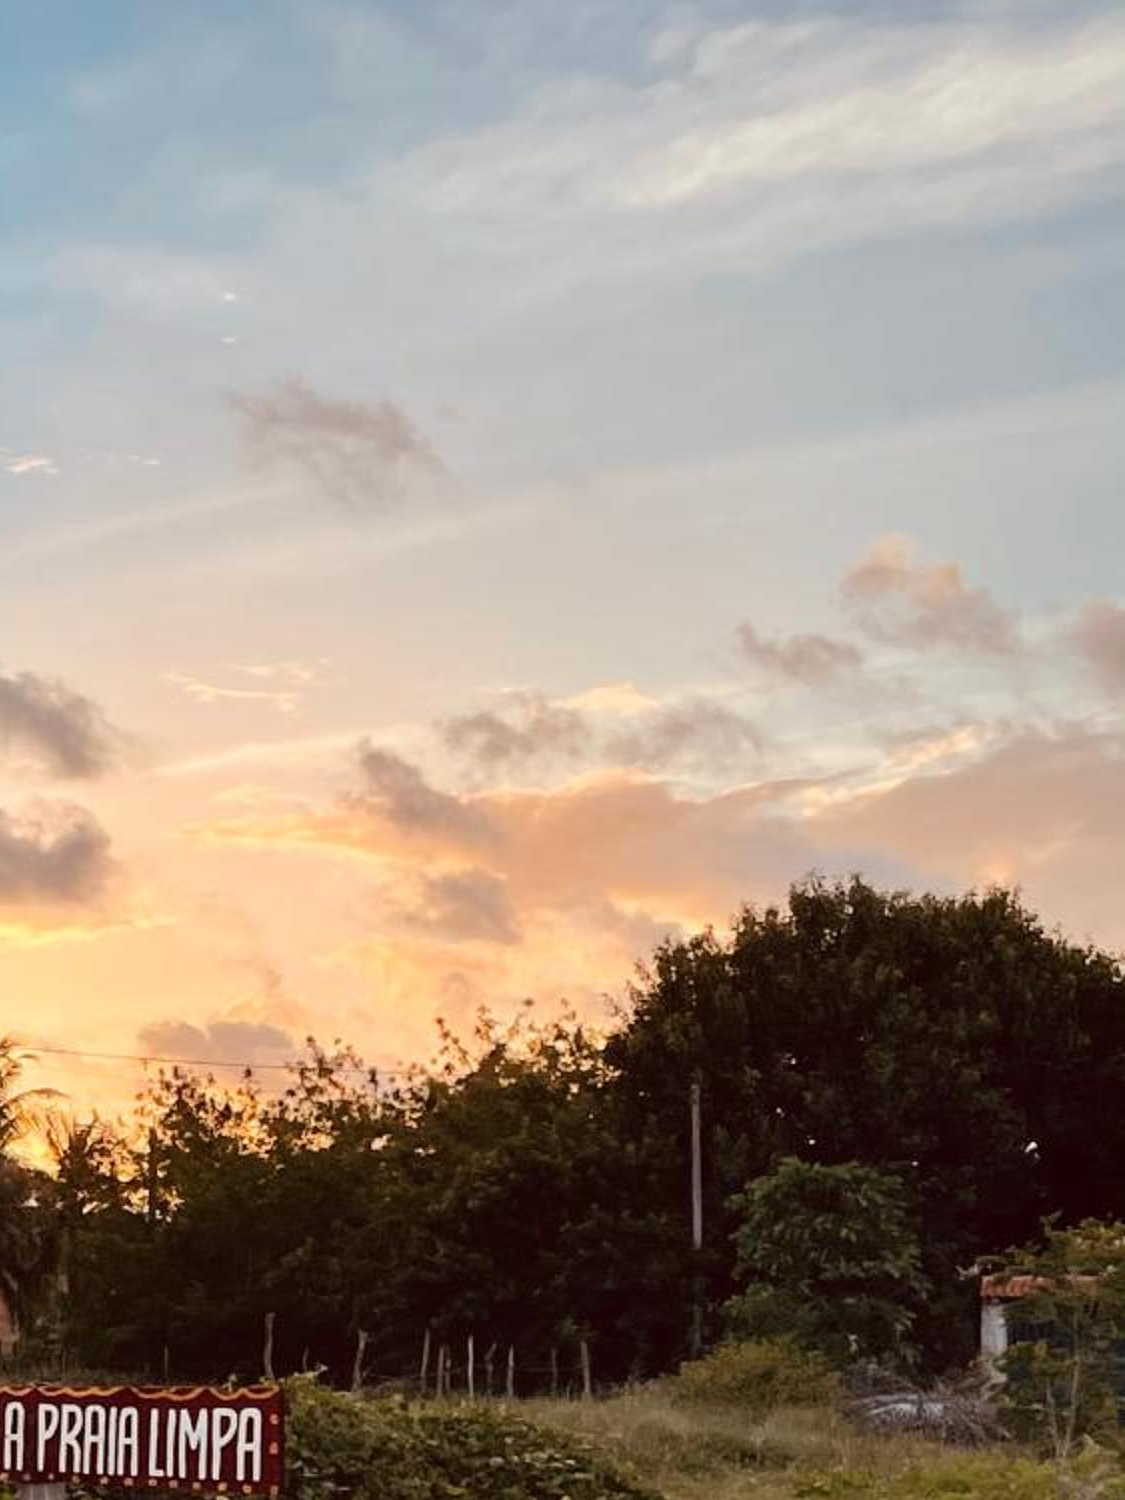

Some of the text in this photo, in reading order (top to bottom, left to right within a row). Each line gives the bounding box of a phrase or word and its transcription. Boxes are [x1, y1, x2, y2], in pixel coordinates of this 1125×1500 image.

[4, 1401, 24, 1471] A
[37, 1404, 138, 1476] PRAIA
[148, 1407, 261, 1481] LIMPA
